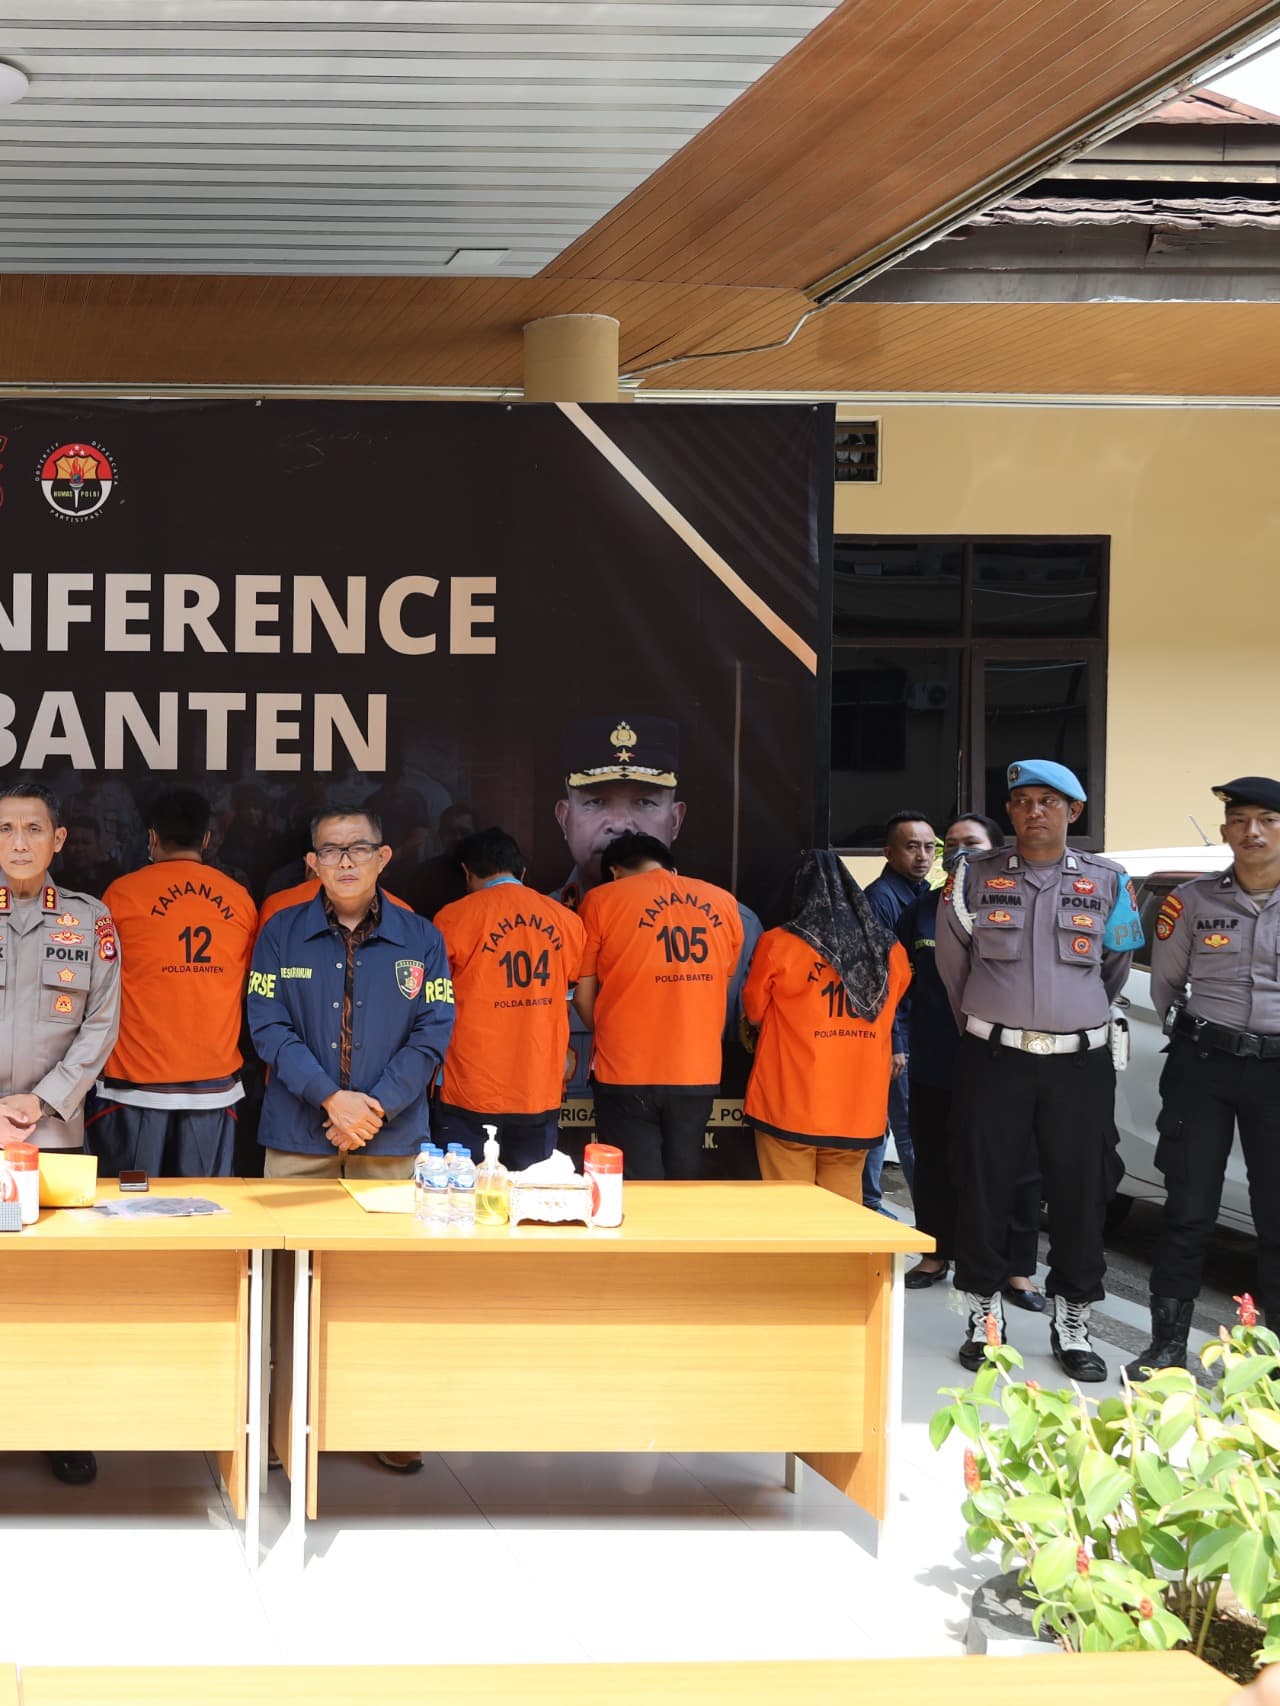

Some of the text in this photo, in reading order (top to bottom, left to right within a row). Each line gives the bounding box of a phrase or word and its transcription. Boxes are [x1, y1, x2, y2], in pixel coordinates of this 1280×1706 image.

[151, 880, 235, 921] TAHANAN
[638, 892, 723, 928] TAHANAN
[1061, 896, 1102, 911] POLRI
[178, 925, 212, 963] 12
[481, 913, 563, 953] TAHANAN
[656, 925, 709, 964] 105
[45, 946, 89, 962] POLRI
[162, 965, 224, 974] POLDA BANTEN
[499, 949, 550, 988] 104
[655, 974, 685, 983] POLDA
[494, 999, 523, 1009] POLDA
[838, 1029, 876, 1039] BANTEN
